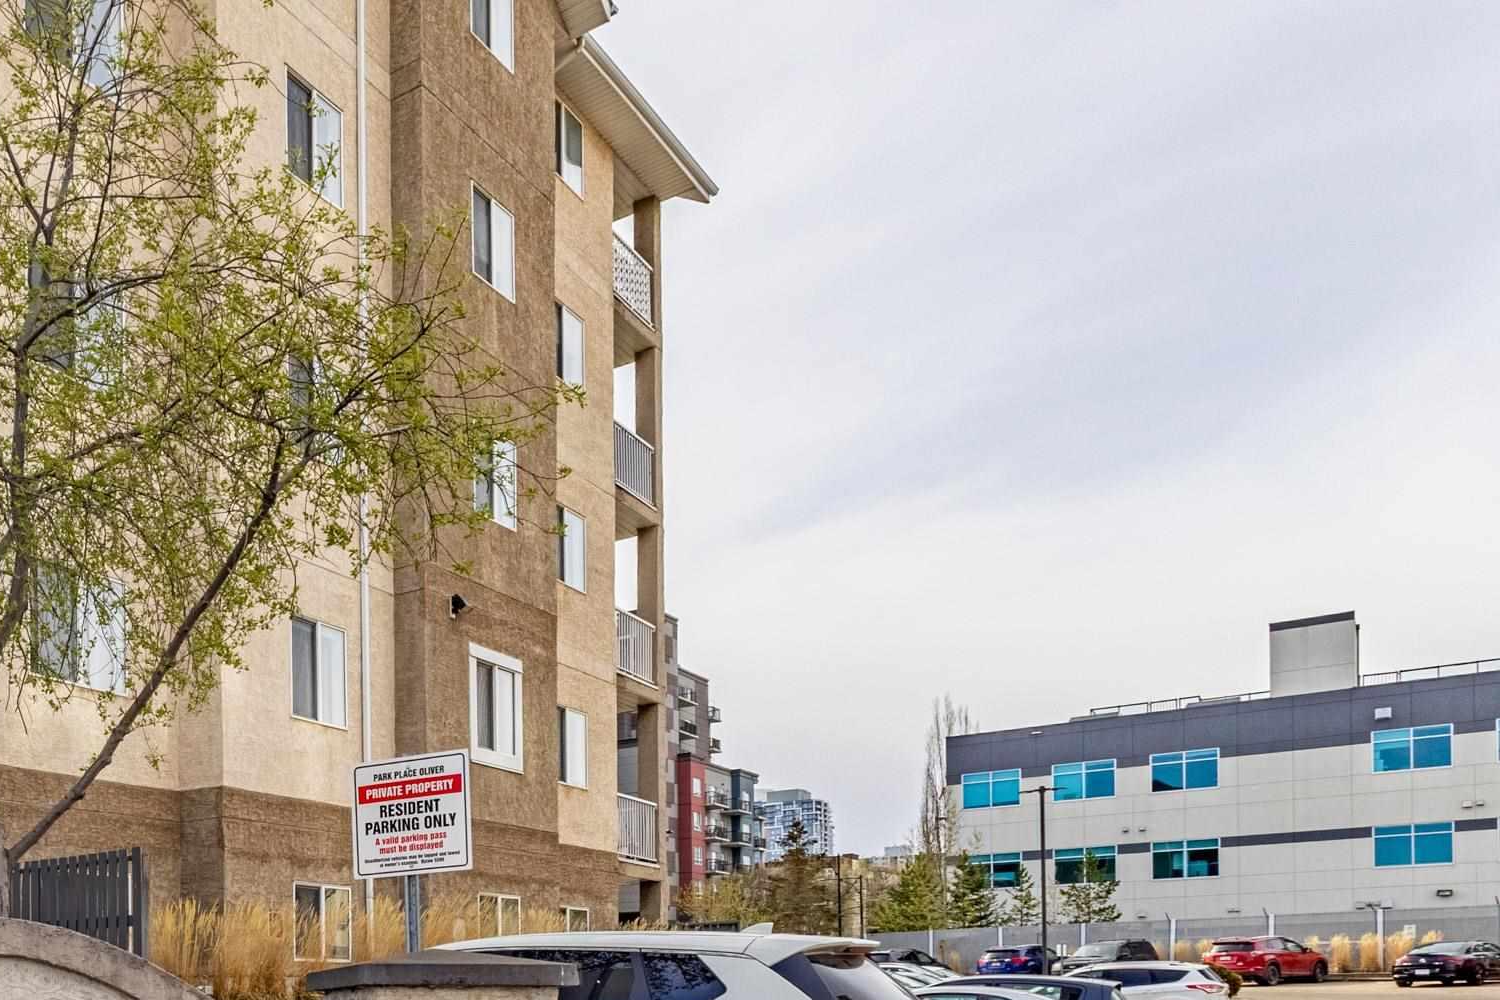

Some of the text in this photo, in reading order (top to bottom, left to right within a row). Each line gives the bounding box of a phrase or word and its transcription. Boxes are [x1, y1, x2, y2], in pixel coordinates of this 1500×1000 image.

[373, 765, 444, 782] PARK PLACE OLIVER
[366, 779, 453, 799] PRIVATE PROPERTY
[380, 799, 440, 818] RESIDENT
[365, 813, 456, 835] PARKING ONLY
[375, 832, 447, 846] A valid parking pass
[380, 840, 444, 854] must be displayed
